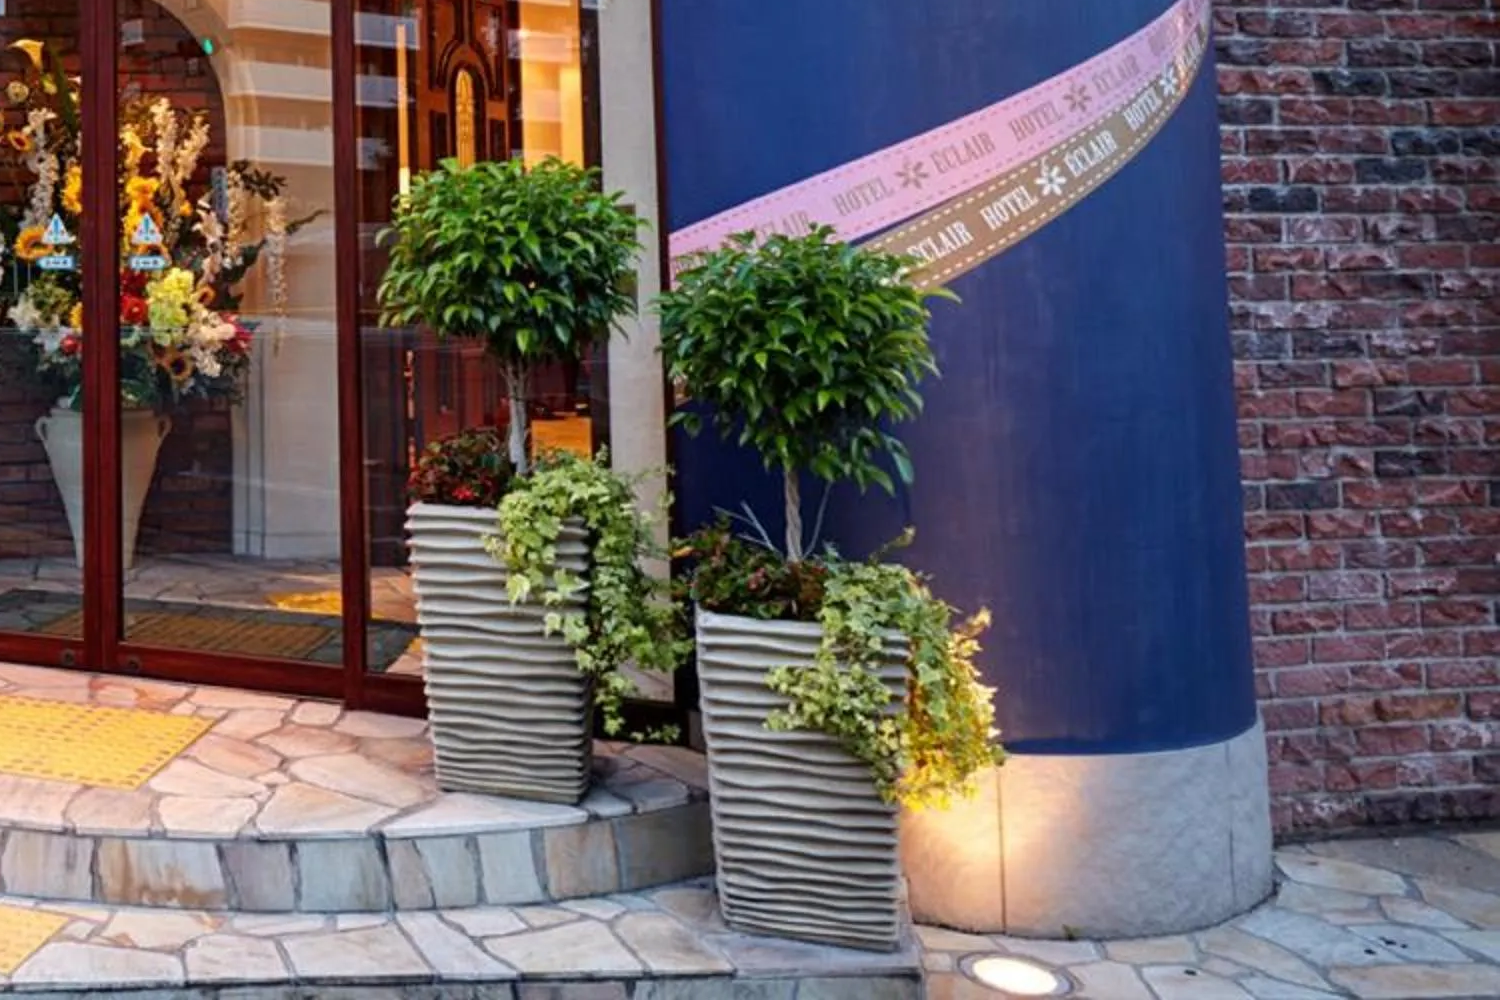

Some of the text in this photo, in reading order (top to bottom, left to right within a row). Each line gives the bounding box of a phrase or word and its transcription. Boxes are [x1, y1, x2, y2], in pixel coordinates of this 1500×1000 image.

[832, 176, 896, 218] HOTEL
[1007, 101, 1067, 143] HOTEL
[979, 184, 1041, 232] HOTEL
